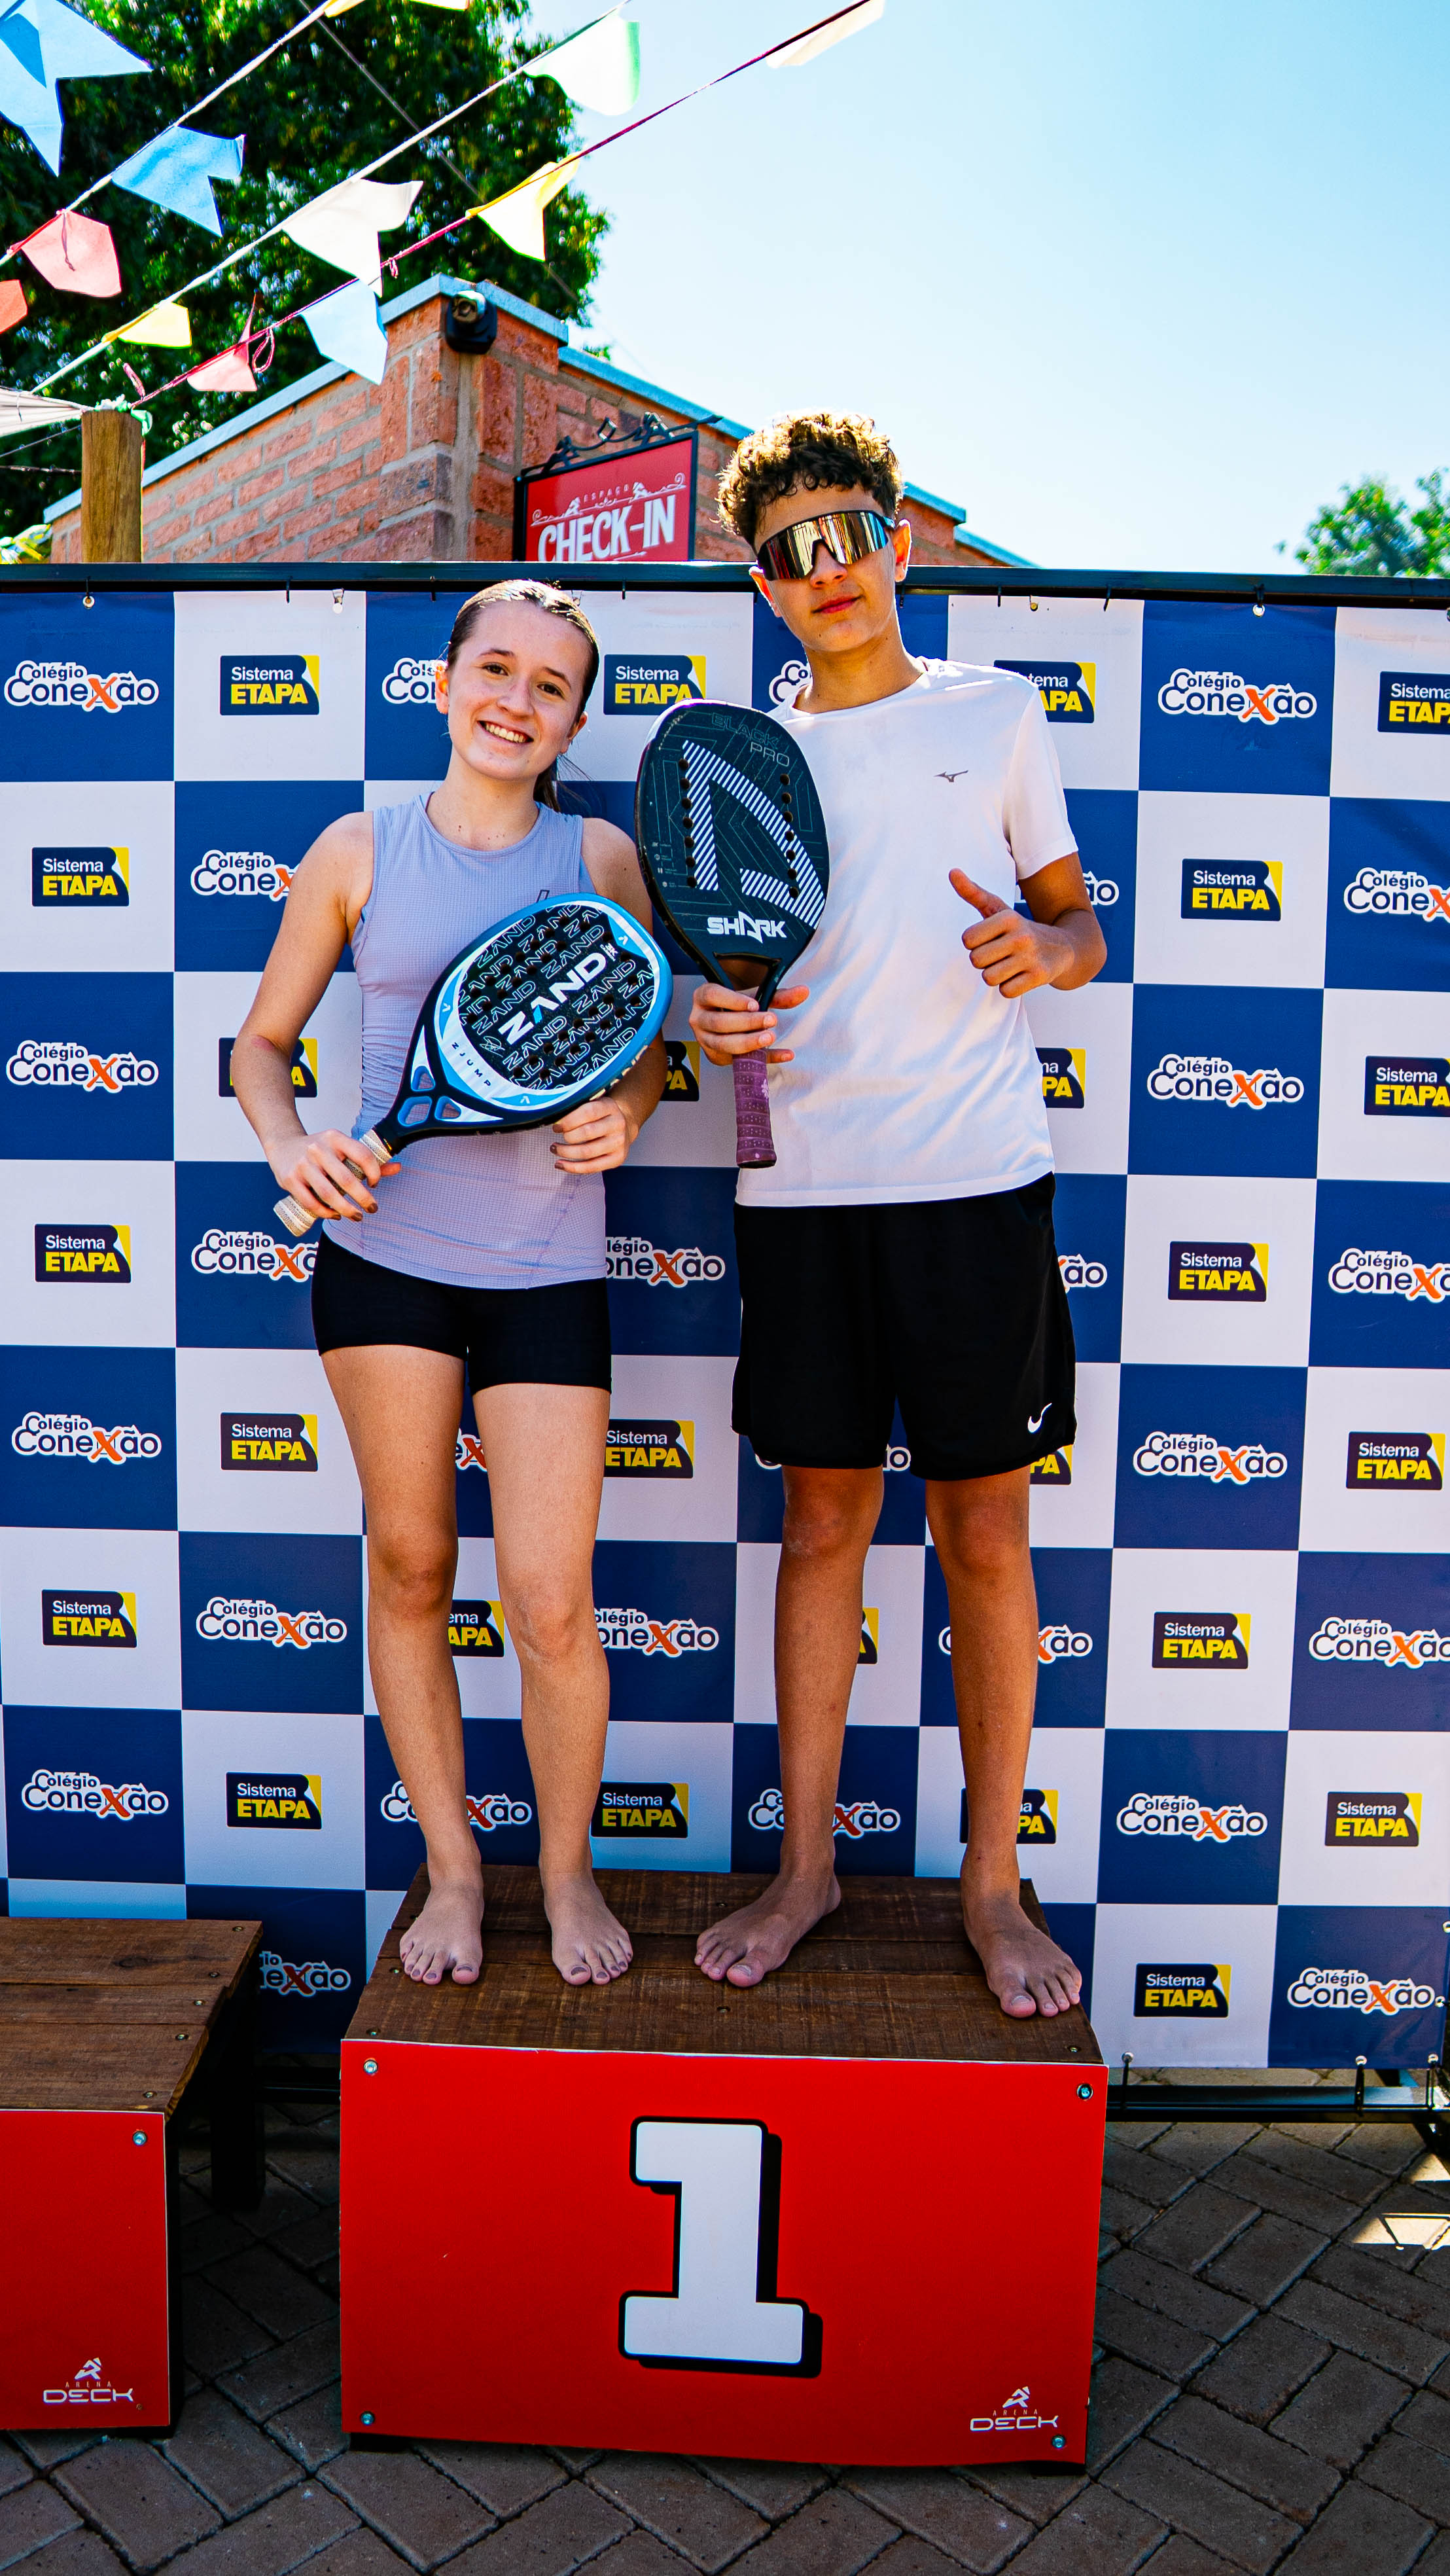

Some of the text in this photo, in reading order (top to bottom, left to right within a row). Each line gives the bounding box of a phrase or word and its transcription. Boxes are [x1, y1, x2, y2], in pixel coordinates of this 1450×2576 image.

[537, 494, 675, 562] CHECK-IN
[19, 664, 83, 681] Colégio
[231, 666, 293, 681] Sistema
[615, 666, 679, 681] Sistema
[1174, 671, 1241, 690] Colégio
[231, 685, 308, 704] ETAPA
[614, 684, 692, 704] ETAPA
[1388, 701, 1450, 724] ETAP
[712, 712, 779, 749] BLACK
[750, 742, 789, 766] PRO
[43, 858, 103, 873] Sistema
[206, 854, 271, 870] Colégio
[43, 876, 118, 896] ETAPA
[1193, 870, 1255, 886] Sistema
[1353, 871, 1424, 890] Colégio
[1192, 888, 1270, 910] ETAPA
[707, 910, 787, 944] SHARK
[498, 952, 607, 1045] ZAND
[21, 1043, 84, 1060] Colégio
[1163, 1057, 1229, 1075] Colégio
[1376, 1067, 1438, 1082] Sistema
[1375, 1084, 1450, 1106] ETAPA
[46, 1235, 105, 1250] Sistema
[208, 1232, 271, 1248] Colégio
[46, 1251, 120, 1273] ETAPA
[1180, 1252, 1242, 1268] Sistema
[1341, 1251, 1408, 1270] Colégio
[1179, 1269, 1255, 1291] ETAPA
[26, 1415, 88, 1432] Colégio
[232, 1424, 292, 1438] Sistema
[606, 1430, 667, 1445] Sistema
[1149, 1435, 1214, 1451] Colégio
[231, 1440, 307, 1461] ETAPA
[605, 1447, 681, 1467] ETAPA
[1358, 1442, 1419, 1458] Sistema
[1356, 1459, 1432, 1480] ETAPA
[52, 1600, 111, 1615] Sistema
[211, 1601, 274, 1617] Colégio
[52, 1616, 126, 1637] ETAPA
[1164, 1622, 1225, 1636] Sistema
[1325, 1620, 1390, 1637] Colégio
[1162, 1638, 1238, 1659] ETAPA
[35, 1773, 97, 1789] Colégio
[237, 1783, 296, 1797] Sistema
[602, 1792, 662, 1806] Sistema
[1132, 1797, 1196, 1812] Colégio
[237, 1798, 311, 1819] ETAPA
[1336, 1802, 1397, 1816] Sistema
[601, 1809, 676, 1828] ETAPA
[1335, 1817, 1408, 1837] ETAPA
[1146, 1975, 1205, 1988] Sistema
[1303, 1971, 1365, 1986] Colégio
[1144, 1989, 1218, 2008] ETAPA
[620, 2118, 818, 2374] 1
[43, 2388, 134, 2403] DECK
[970, 2415, 1059, 2431] DECK
